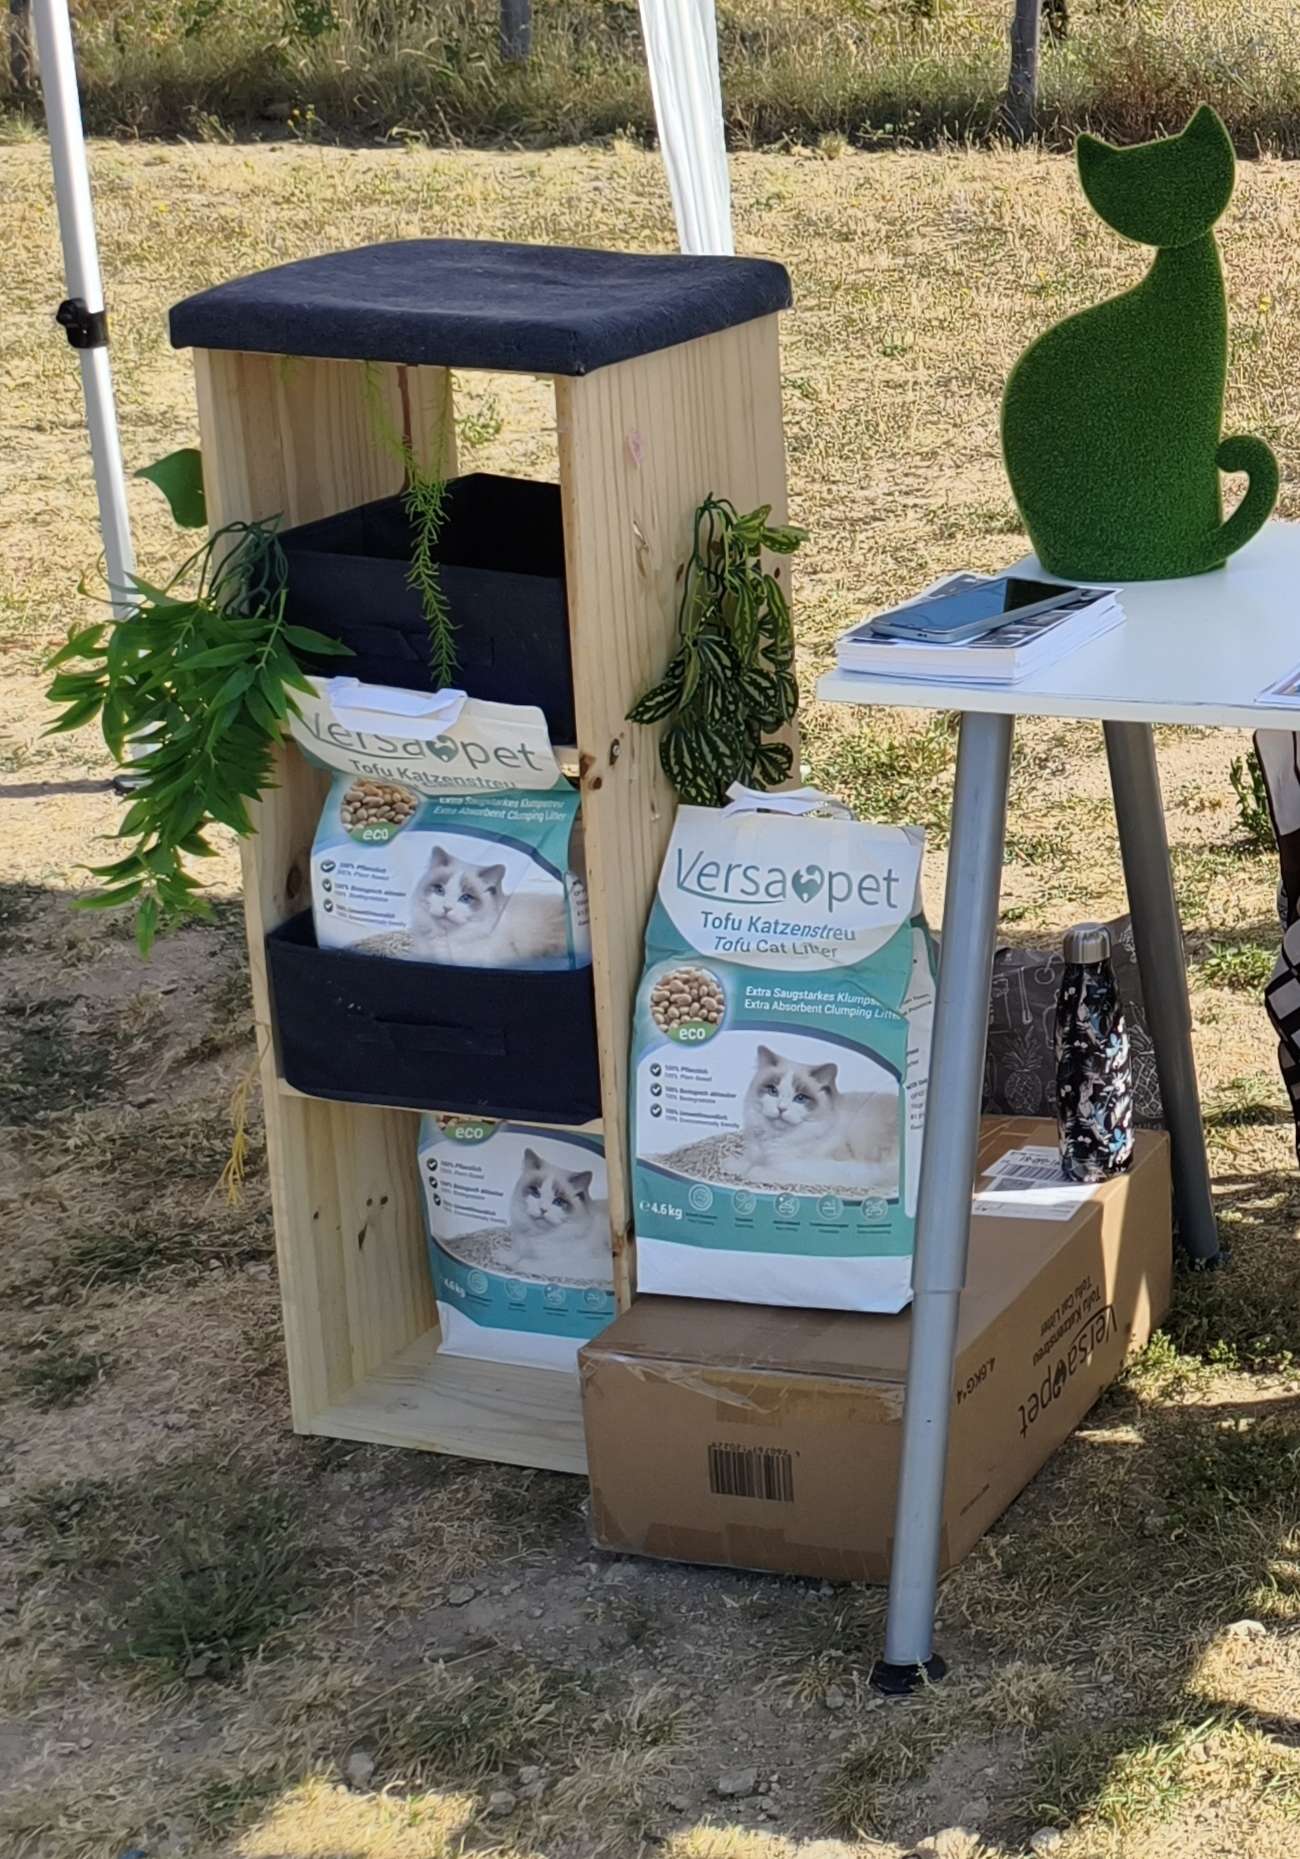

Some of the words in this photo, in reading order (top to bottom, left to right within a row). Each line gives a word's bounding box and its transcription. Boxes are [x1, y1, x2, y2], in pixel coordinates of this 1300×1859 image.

[349, 759, 393, 777] Tofu
[362, 828, 389, 840] eco
[701, 911, 742, 931] Tofu
[747, 916, 856, 941] Katzenstreu
[714, 936, 751, 953] Tofu
[756, 939, 787, 955] Cat
[792, 942, 839, 959] Litter
[745, 986, 771, 997] Extra
[773, 987, 835, 1002] Saugstarkes
[744, 999, 770, 1010] Extra
[771, 1001, 822, 1014] Absorbent
[824, 1004, 873, 1019] Clumping
[679, 1027, 706, 1040] eco
[455, 1127, 484, 1140] eco
